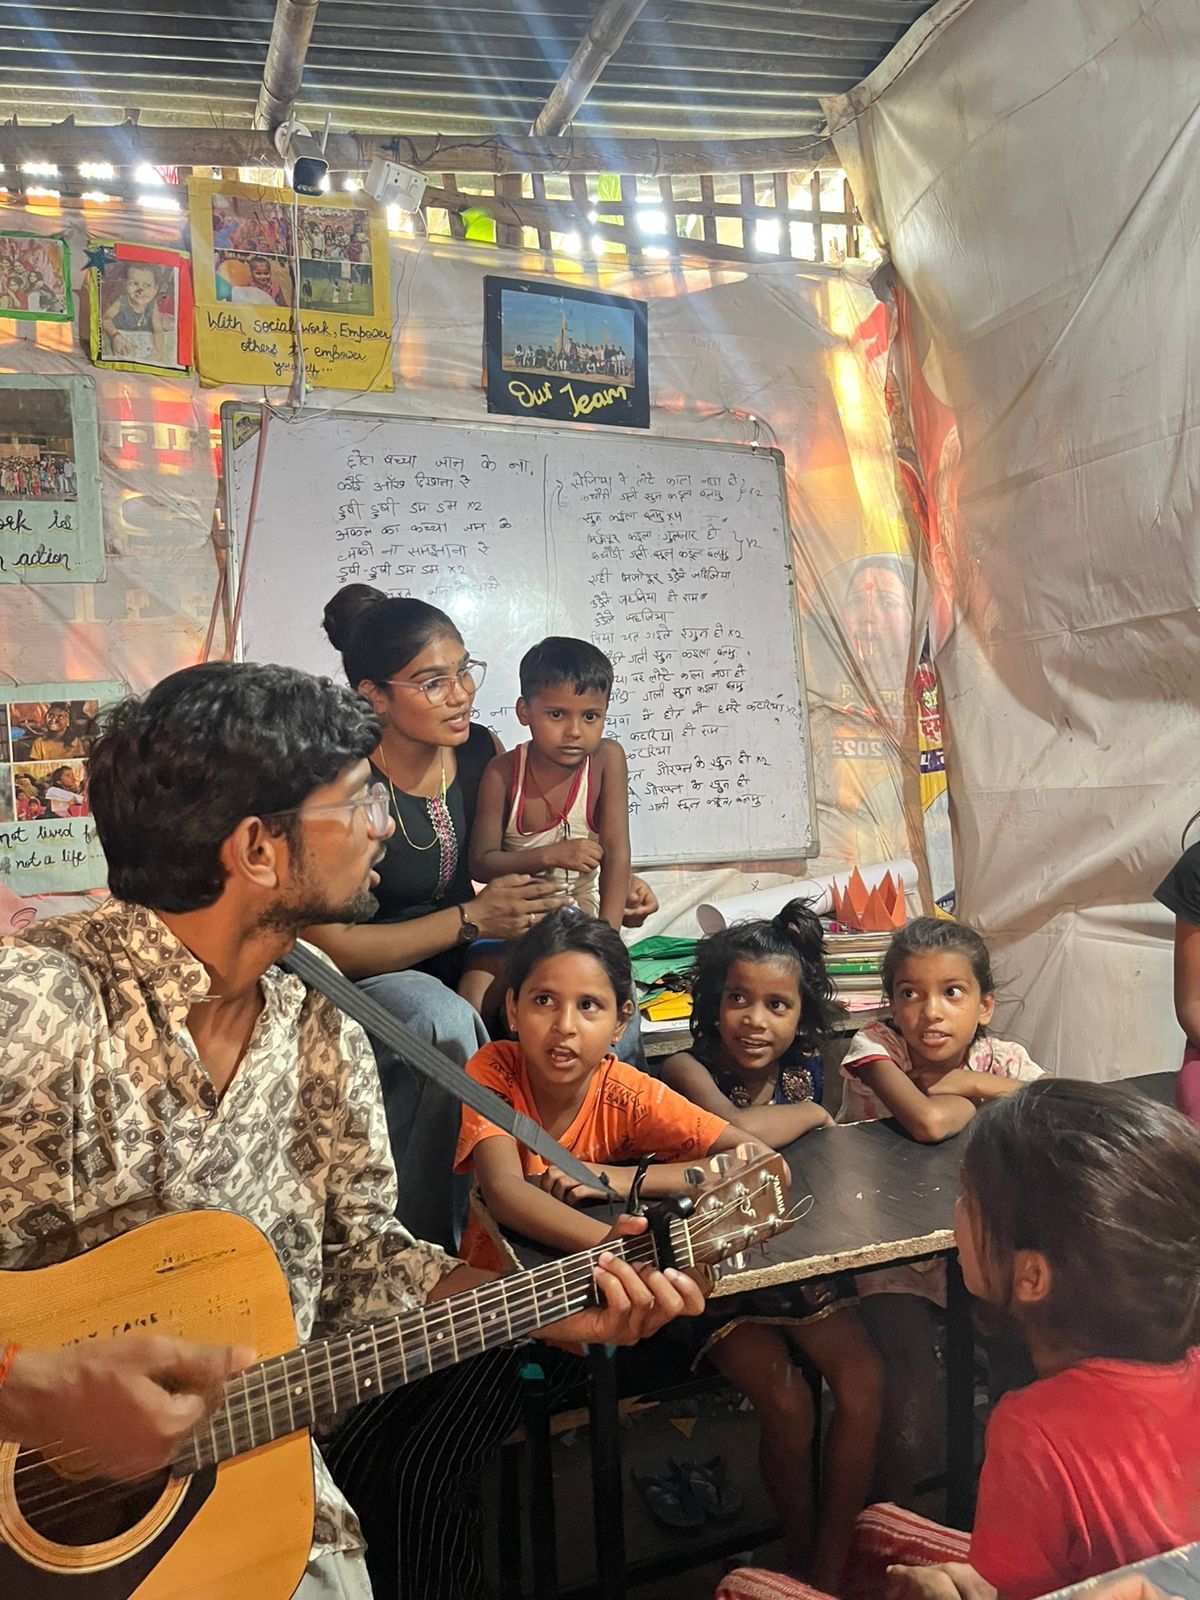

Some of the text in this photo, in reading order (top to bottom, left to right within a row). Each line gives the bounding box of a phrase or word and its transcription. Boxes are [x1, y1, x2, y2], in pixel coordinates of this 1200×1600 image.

[207, 311, 246, 335] With
[253, 317, 296, 335] social
[508, 380, 627, 418] Our Team
[36, 822, 73, 840] lived
[16, 853, 41, 870] not
[772, 1174, 786, 1215] YAMAHA
